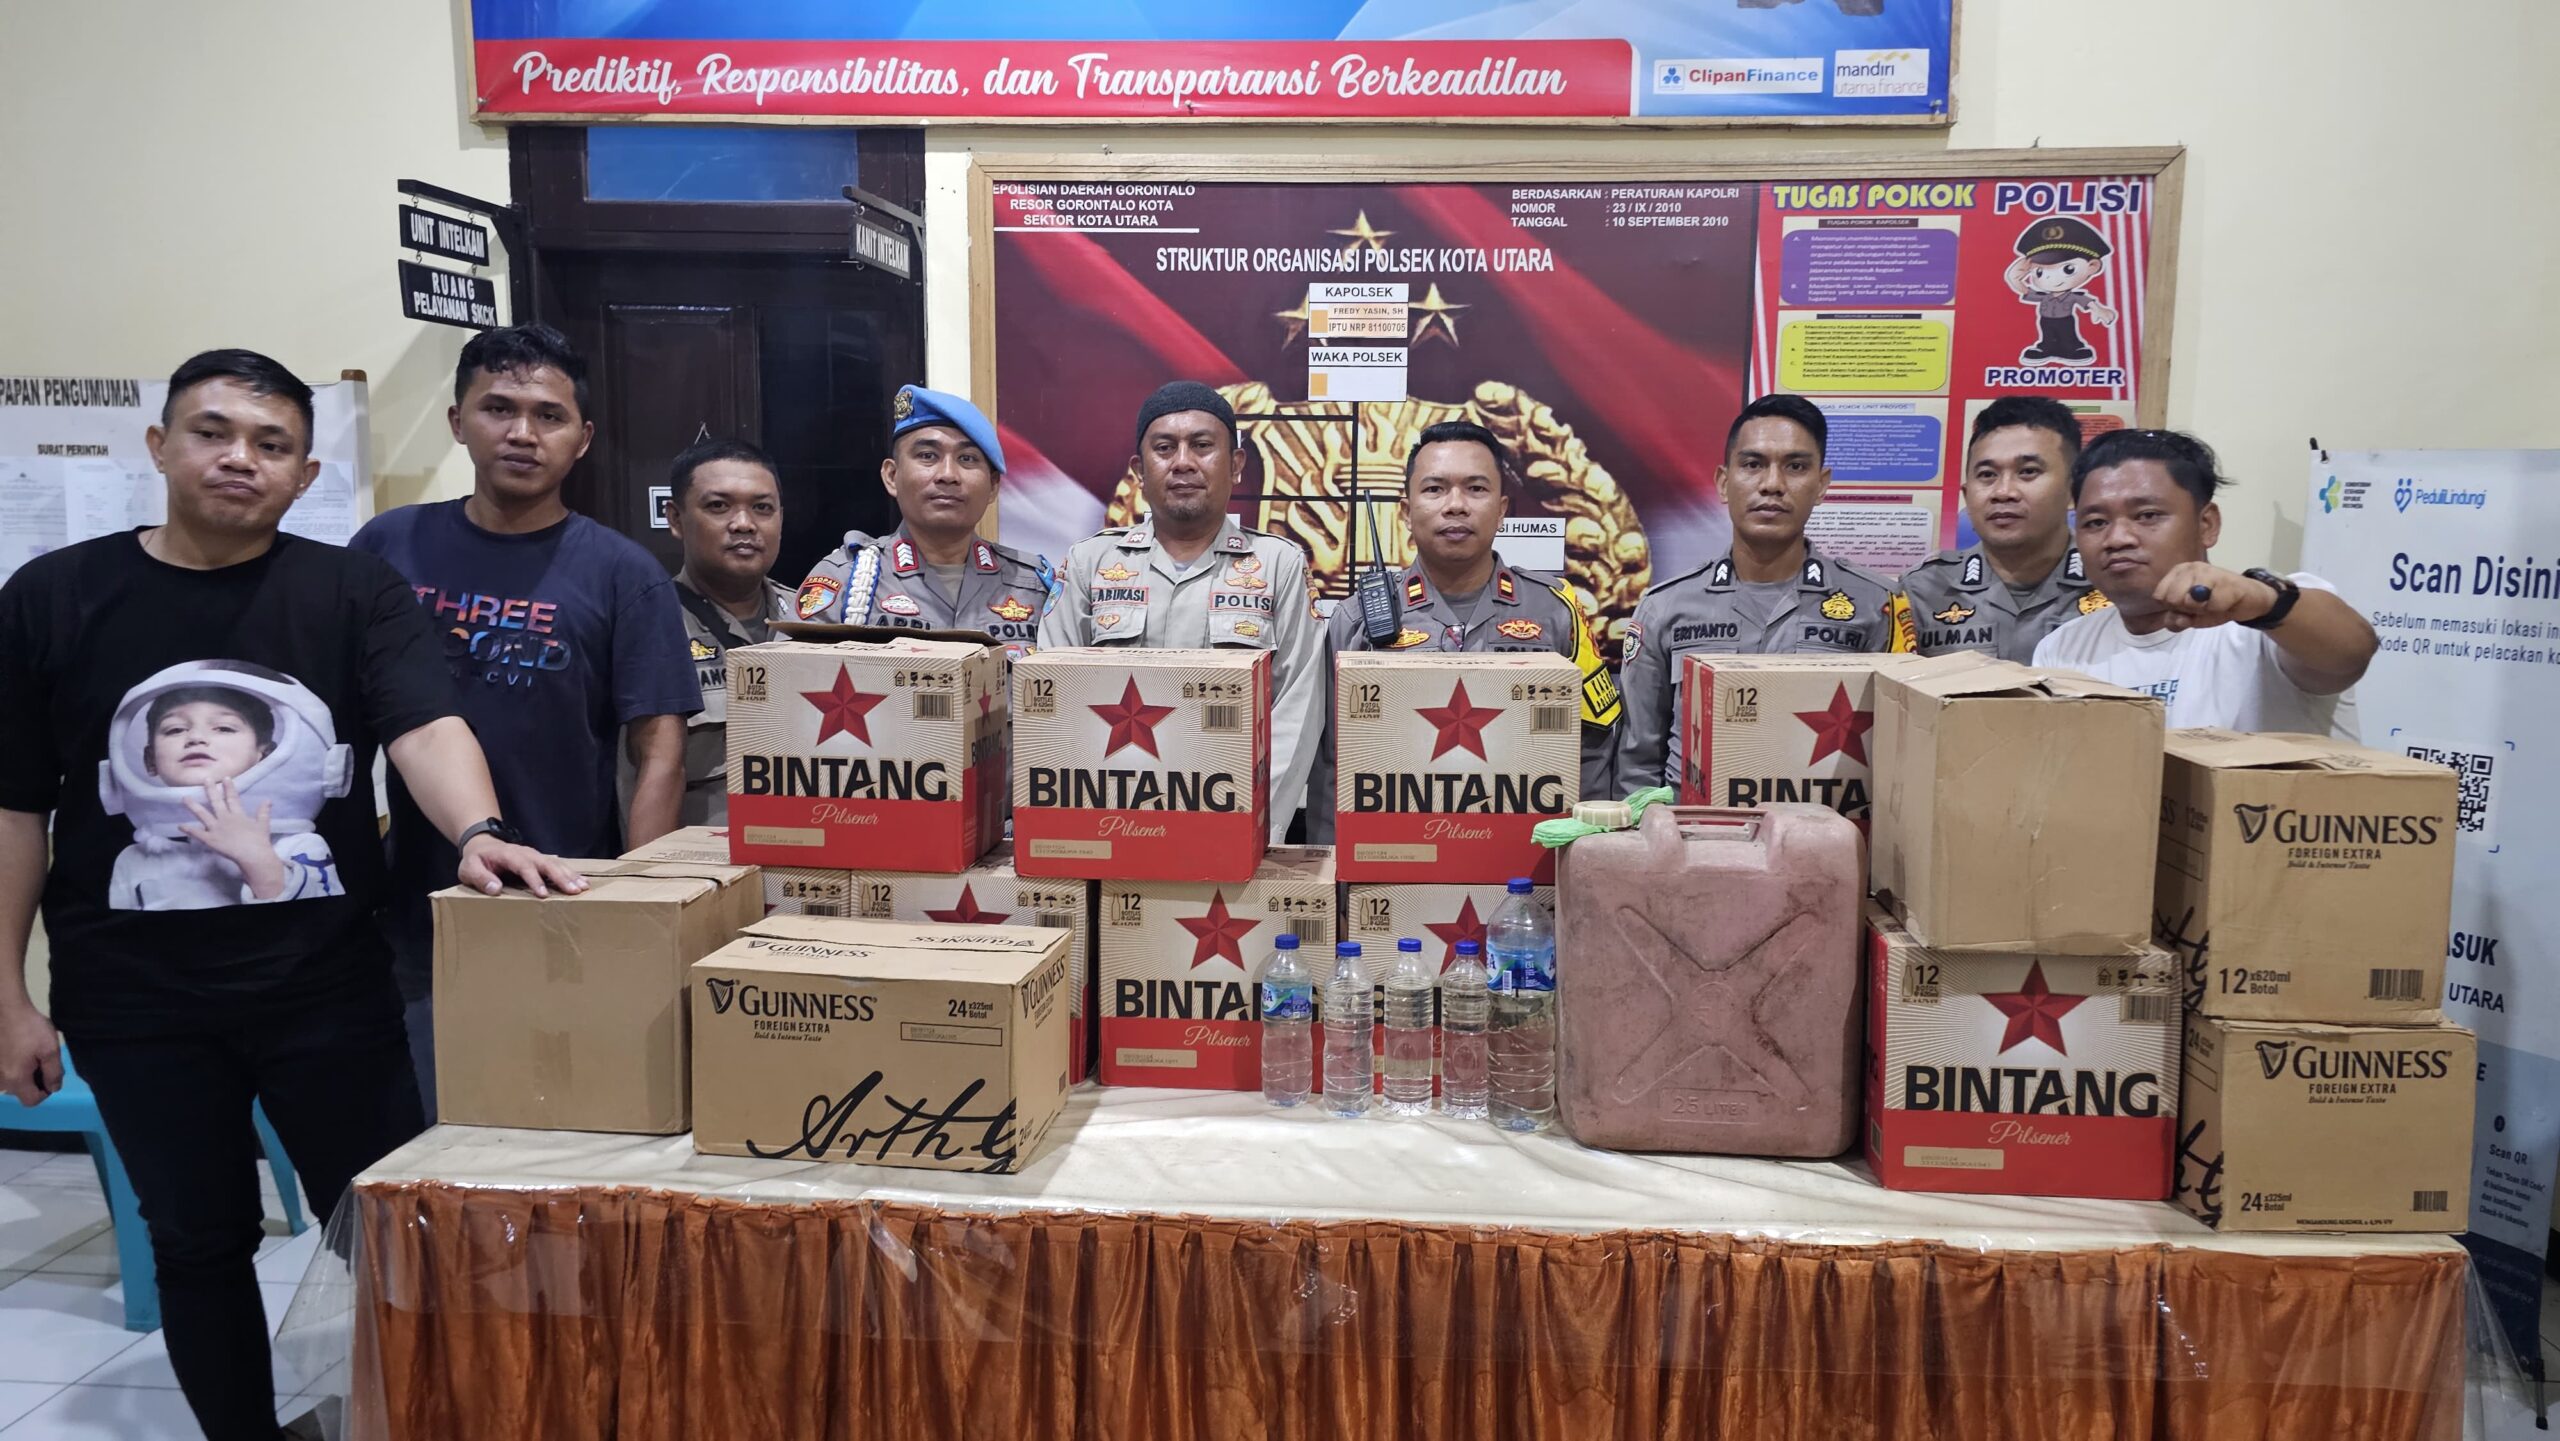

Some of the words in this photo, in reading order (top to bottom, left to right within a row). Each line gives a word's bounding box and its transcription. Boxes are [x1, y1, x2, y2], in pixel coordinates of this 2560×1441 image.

[513, 52, 682, 106] Prediktif,
[983, 57, 1058, 96] dan
[1068, 52, 1321, 109] Transparansi
[1331, 54, 1567, 99] Berkeadilan
[1688, 67, 1819, 86] ClipanFinance
[1836, 62, 1895, 78] mandiri
[1877, 79, 1927, 95] finance
[993, 183, 1058, 195] EPOLISIAN
[1060, 184, 1113, 196] DAERAH
[1116, 184, 1196, 196] GORONTALO
[1512, 189, 1602, 200] BERDASARKAN
[1611, 188, 1684, 199] PERATURAN
[1686, 188, 1739, 199] KAPOLRI
[1773, 184, 1859, 209] TUGAS
[1867, 184, 1976, 208] POKOK
[1997, 184, 2142, 213] POLISI
[1010, 199, 1054, 211] RESOR
[1056, 199, 1136, 211] GORONTALO
[1138, 199, 1174, 211] KOTA
[1511, 203, 1556, 213] NOMOR
[1612, 203, 1626, 213] 23
[1635, 203, 1647, 213] IX
[1655, 202, 1681, 213] 2010
[1023, 214, 1075, 226] SEKTOR
[1077, 214, 1112, 226] KOTA
[1115, 214, 1159, 226] UTARA
[1511, 217, 1568, 228] TANGGAL
[1612, 216, 1625, 227] 10
[1627, 216, 1700, 227] SEPTEMBER
[1702, 216, 1729, 227] 2010
[410, 212, 435, 246] UNIT
[438, 221, 485, 259] INTELKAM
[855, 223, 877, 262] KANIT
[877, 231, 910, 273] INTELKAM
[1156, 247, 1248, 272] STRUKTUR
[1252, 247, 1360, 273] ORGANISASI
[1364, 248, 1434, 272] POLSEK
[1439, 248, 1489, 272] KOTA
[1493, 247, 1554, 272] UTARA
[431, 272, 476, 301] RUANG
[1325, 286, 1393, 298] KAPOLSEK
[413, 291, 469, 322] PELAYANAN
[471, 303, 496, 328] SKCK
[1333, 307, 1360, 315] FREDY
[1362, 307, 1391, 316] YASIN,
[1392, 307, 1404, 315] SH
[1328, 322, 1348, 332] IPTU
[1349, 322, 1366, 332] NRP
[1311, 351, 1349, 363] WAKA
[1352, 351, 1403, 363] POLSEK
[1986, 368, 2124, 386] PROMOTER
[44, 378, 141, 408] PENGUMUMAN
[37, 444, 64, 456] SURAT
[66, 444, 109, 456] PERINTAH
[1512, 523, 1557, 533] HUMAS
[2389, 552, 2462, 595] Scan
[2472, 555, 2560, 600] Disini
[411, 583, 557, 634] THREE
[1673, 621, 1738, 642] ERIYANTO
[2372, 611, 2426, 630] Sebelum
[2430, 615, 2497, 636] memasuki
[2501, 617, 2543, 638] lokasi
[1804, 625, 1862, 646] POLRI
[1918, 625, 1993, 649] ULMAN
[2378, 635, 2408, 652] Kode
[2412, 637, 2430, 654] QR
[2434, 639, 2470, 657] untuk
[2474, 641, 2543, 665] pelacakan
[746, 666, 767, 686] 12
[1033, 679, 1054, 697] 12
[1360, 684, 1381, 702] 12
[1736, 687, 1758, 706] 12
[743, 754, 948, 801] BINTANG
[1029, 767, 1236, 812] BINTANG
[1354, 772, 1564, 815] BINTANG
[1728, 778, 1872, 820] BINTA
[810, 803, 879, 826] Pilsener
[1097, 815, 1168, 838] Pilsener
[1423, 818, 1495, 840] Pilsener
[2273, 809, 2438, 845] GUINNESS
[2288, 847, 2341, 860] FOREIGN
[2343, 848, 2382, 860] EXTRA
[872, 884, 891, 902] 12
[1120, 892, 1141, 911] 12
[1369, 898, 1390, 916] 12
[767, 944, 873, 959] GUINNESS
[1028, 955, 1067, 1010] GUINNESS
[1914, 964, 1940, 986] 12
[2218, 967, 2248, 995] 12
[2250, 970, 2291, 983] x620ml
[2250, 983, 2279, 995] Botol
[2449, 982, 2505, 1014] UTARA
[738, 984, 875, 1022] GUINNESS
[948, 999, 968, 1018] 24
[1115, 978, 1318, 1024] BINTA
[969, 1011, 987, 1020] Botol
[754, 1019, 796, 1032] FOREIGN
[798, 1021, 831, 1034] EXTRA
[1183, 1025, 1252, 1047] Pilsener
[2292, 1045, 2448, 1079] GUINNESS
[1904, 1064, 2160, 1118] BINTANG
[2309, 1083, 2357, 1095] FOREIGN
[2360, 1083, 2397, 1095] EXTRA
[1671, 1096, 1699, 1115] 25
[1703, 1101, 1750, 1117] LITER
[1987, 1119, 2073, 1146] Pilsener
[2488, 1143, 2512, 1161] Scan
[2514, 1151, 2528, 1166] QR
[2240, 1192, 2264, 1212] 24
[2264, 1202, 2285, 1212] Botol
